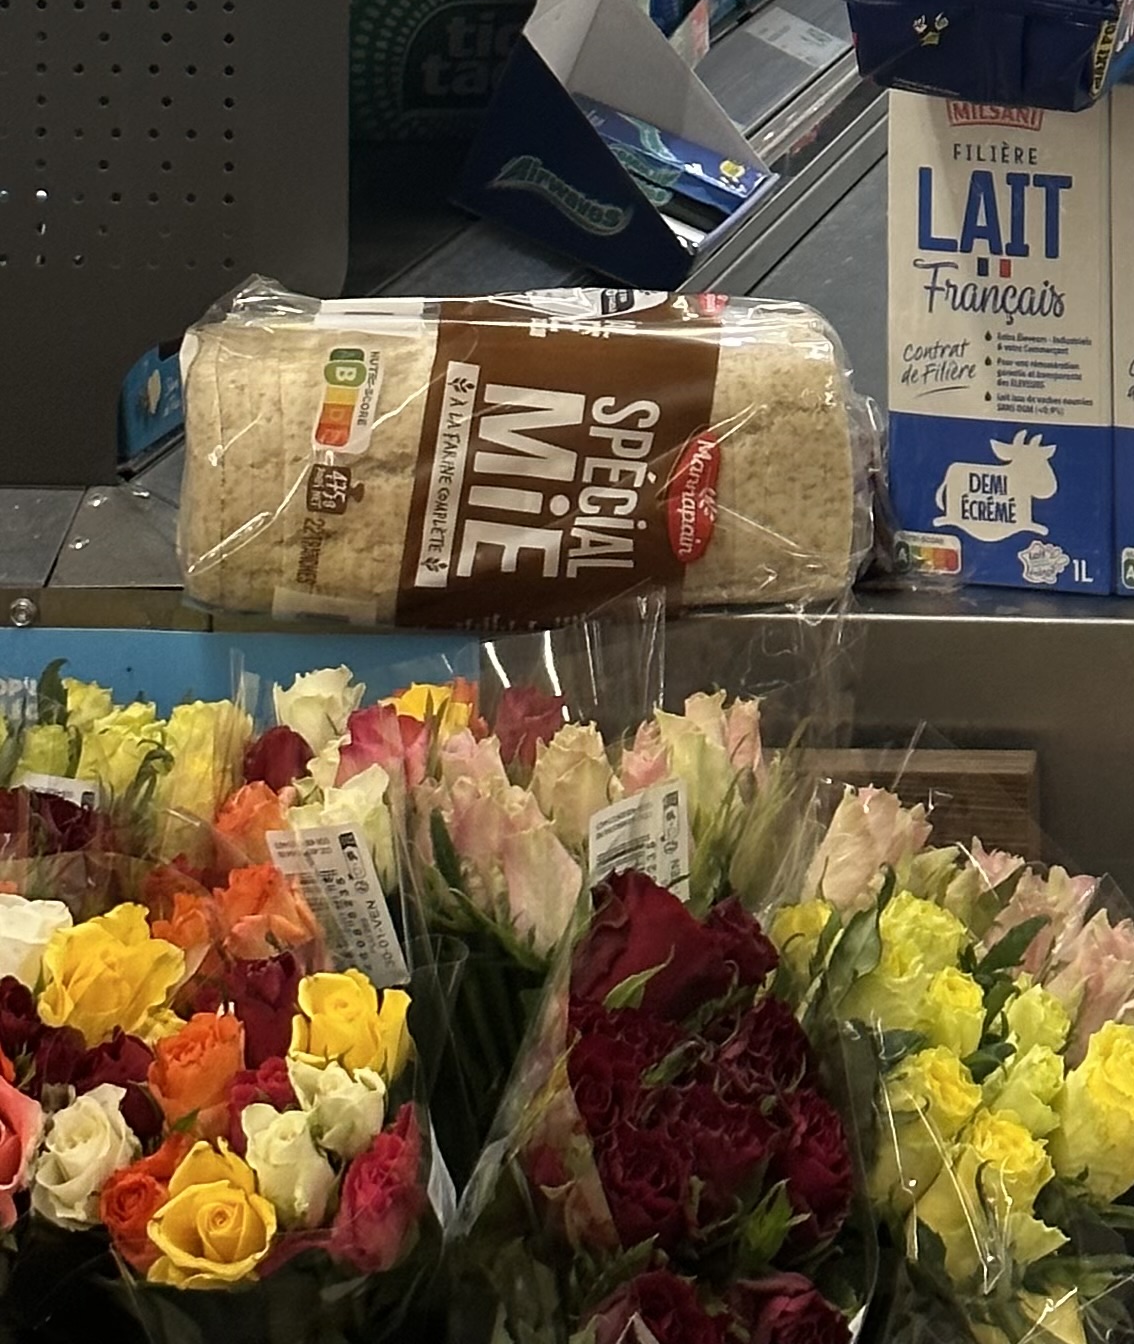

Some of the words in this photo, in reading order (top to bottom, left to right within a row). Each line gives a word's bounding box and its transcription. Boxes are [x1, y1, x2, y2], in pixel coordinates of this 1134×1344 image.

[953, 141, 1039, 165] FILIÈRE
[497, 156, 626, 227] Airwaves
[918, 166, 1072, 259] LAIT
[913, 259, 1065, 325] Français
[903, 338, 970, 362] Contrat
[335, 366, 357, 381] B
[901, 364, 920, 385] de
[923, 361, 977, 385] Filière
[448, 411, 465, 429] LA
[969, 473, 1007, 495] DEMI
[679, 439, 716, 556] Mannapain
[961, 494, 1016, 524] ÉCRÉMÉ
[304, 518, 325, 536] 22
[428, 486, 451, 554] COMPLÈTE
[1073, 559, 1093, 583] 1L
